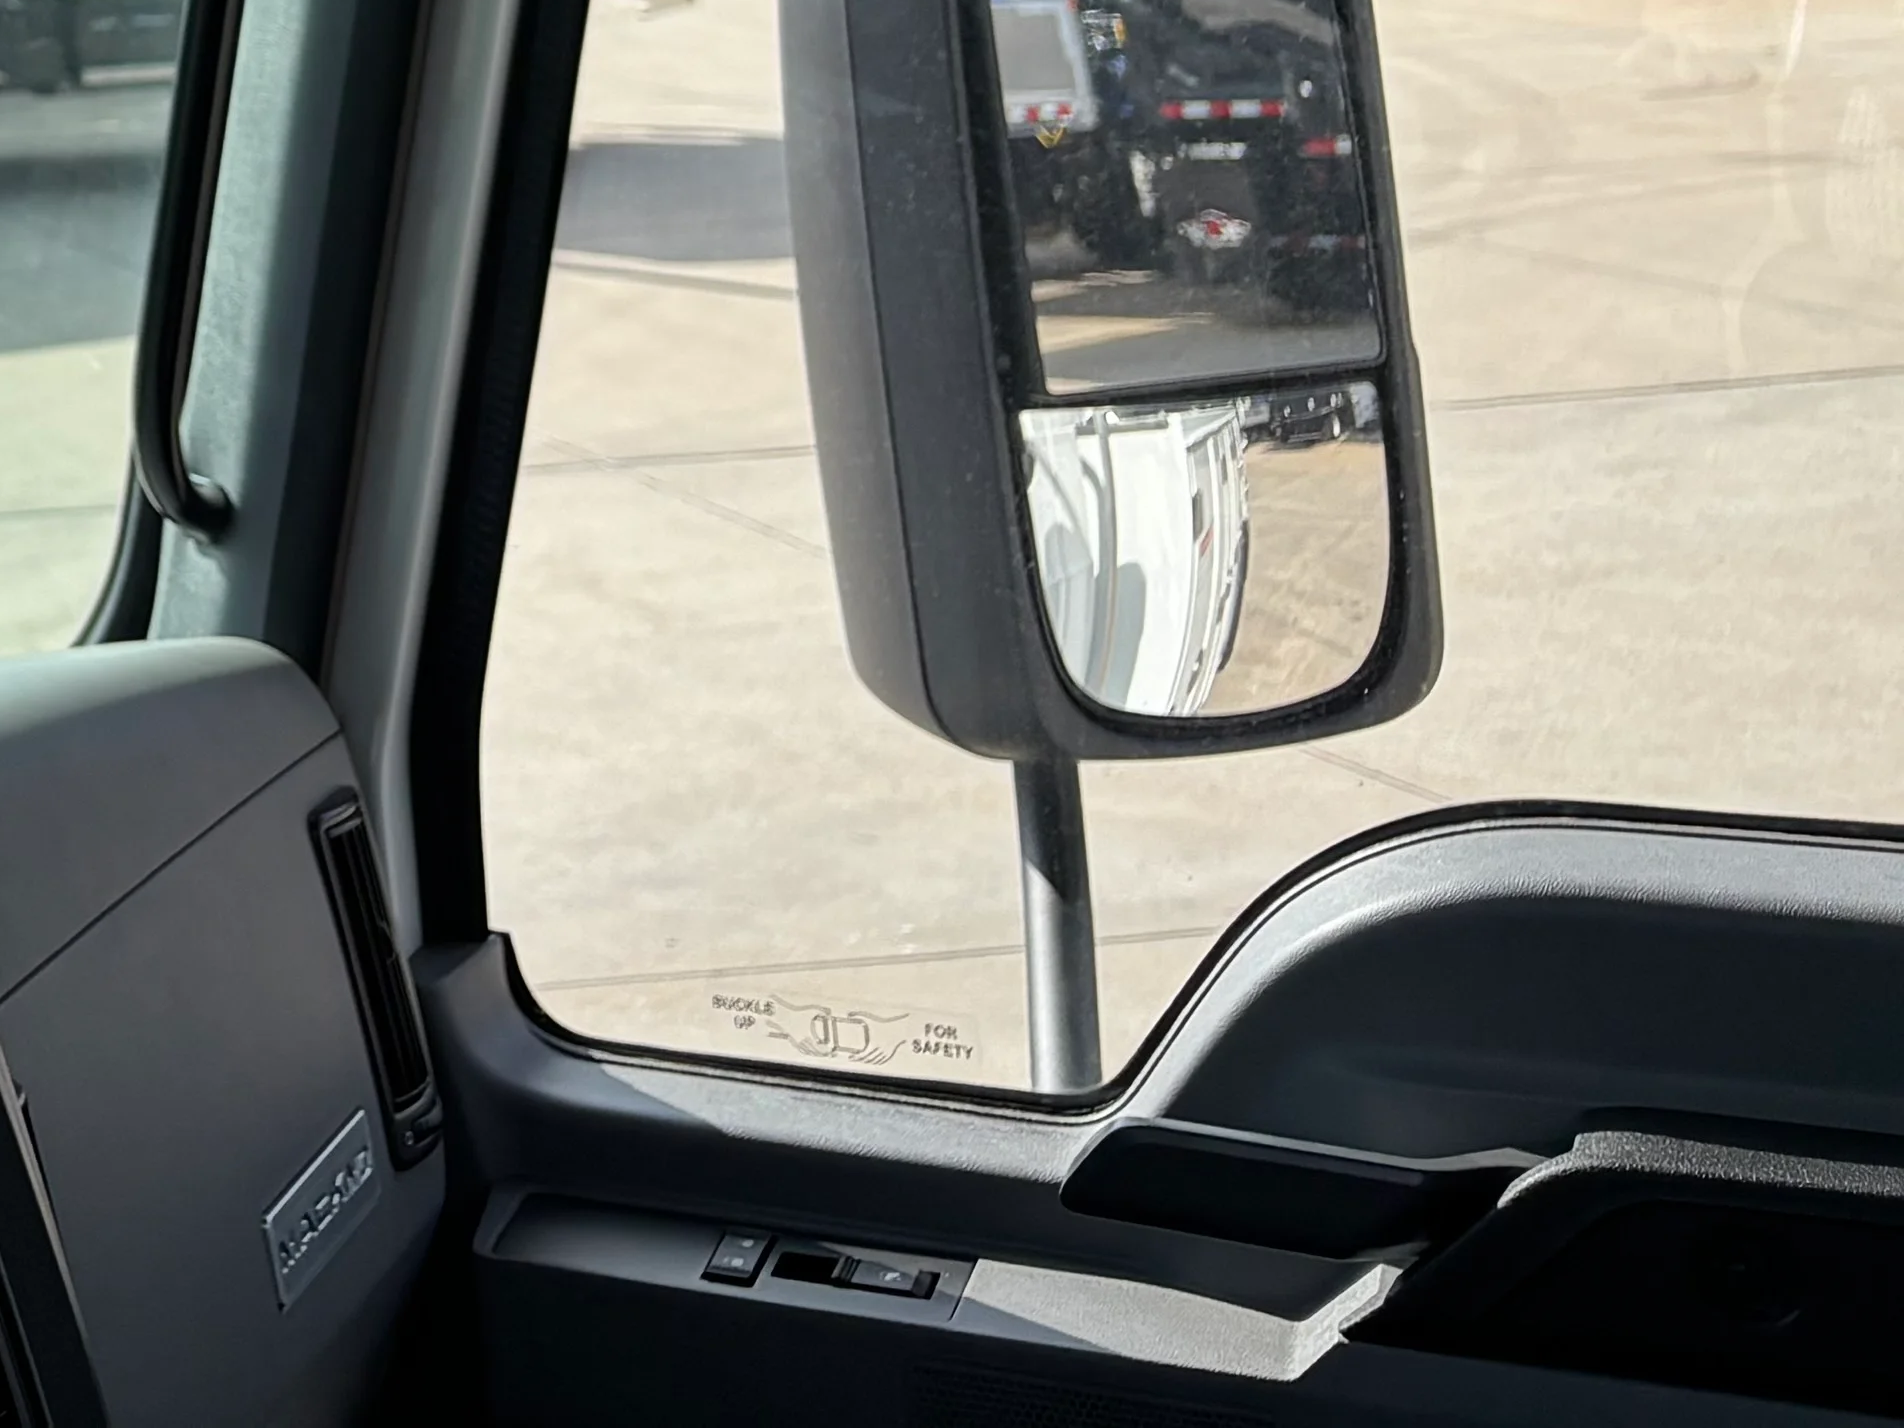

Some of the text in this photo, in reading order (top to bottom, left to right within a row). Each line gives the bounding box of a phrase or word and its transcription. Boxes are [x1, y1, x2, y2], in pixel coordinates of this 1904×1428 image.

[712, 993, 776, 1016] BUCKLE
[733, 1014, 756, 1031] UP
[924, 1022, 958, 1040] FOR
[911, 1038, 974, 1060] SAFETY
